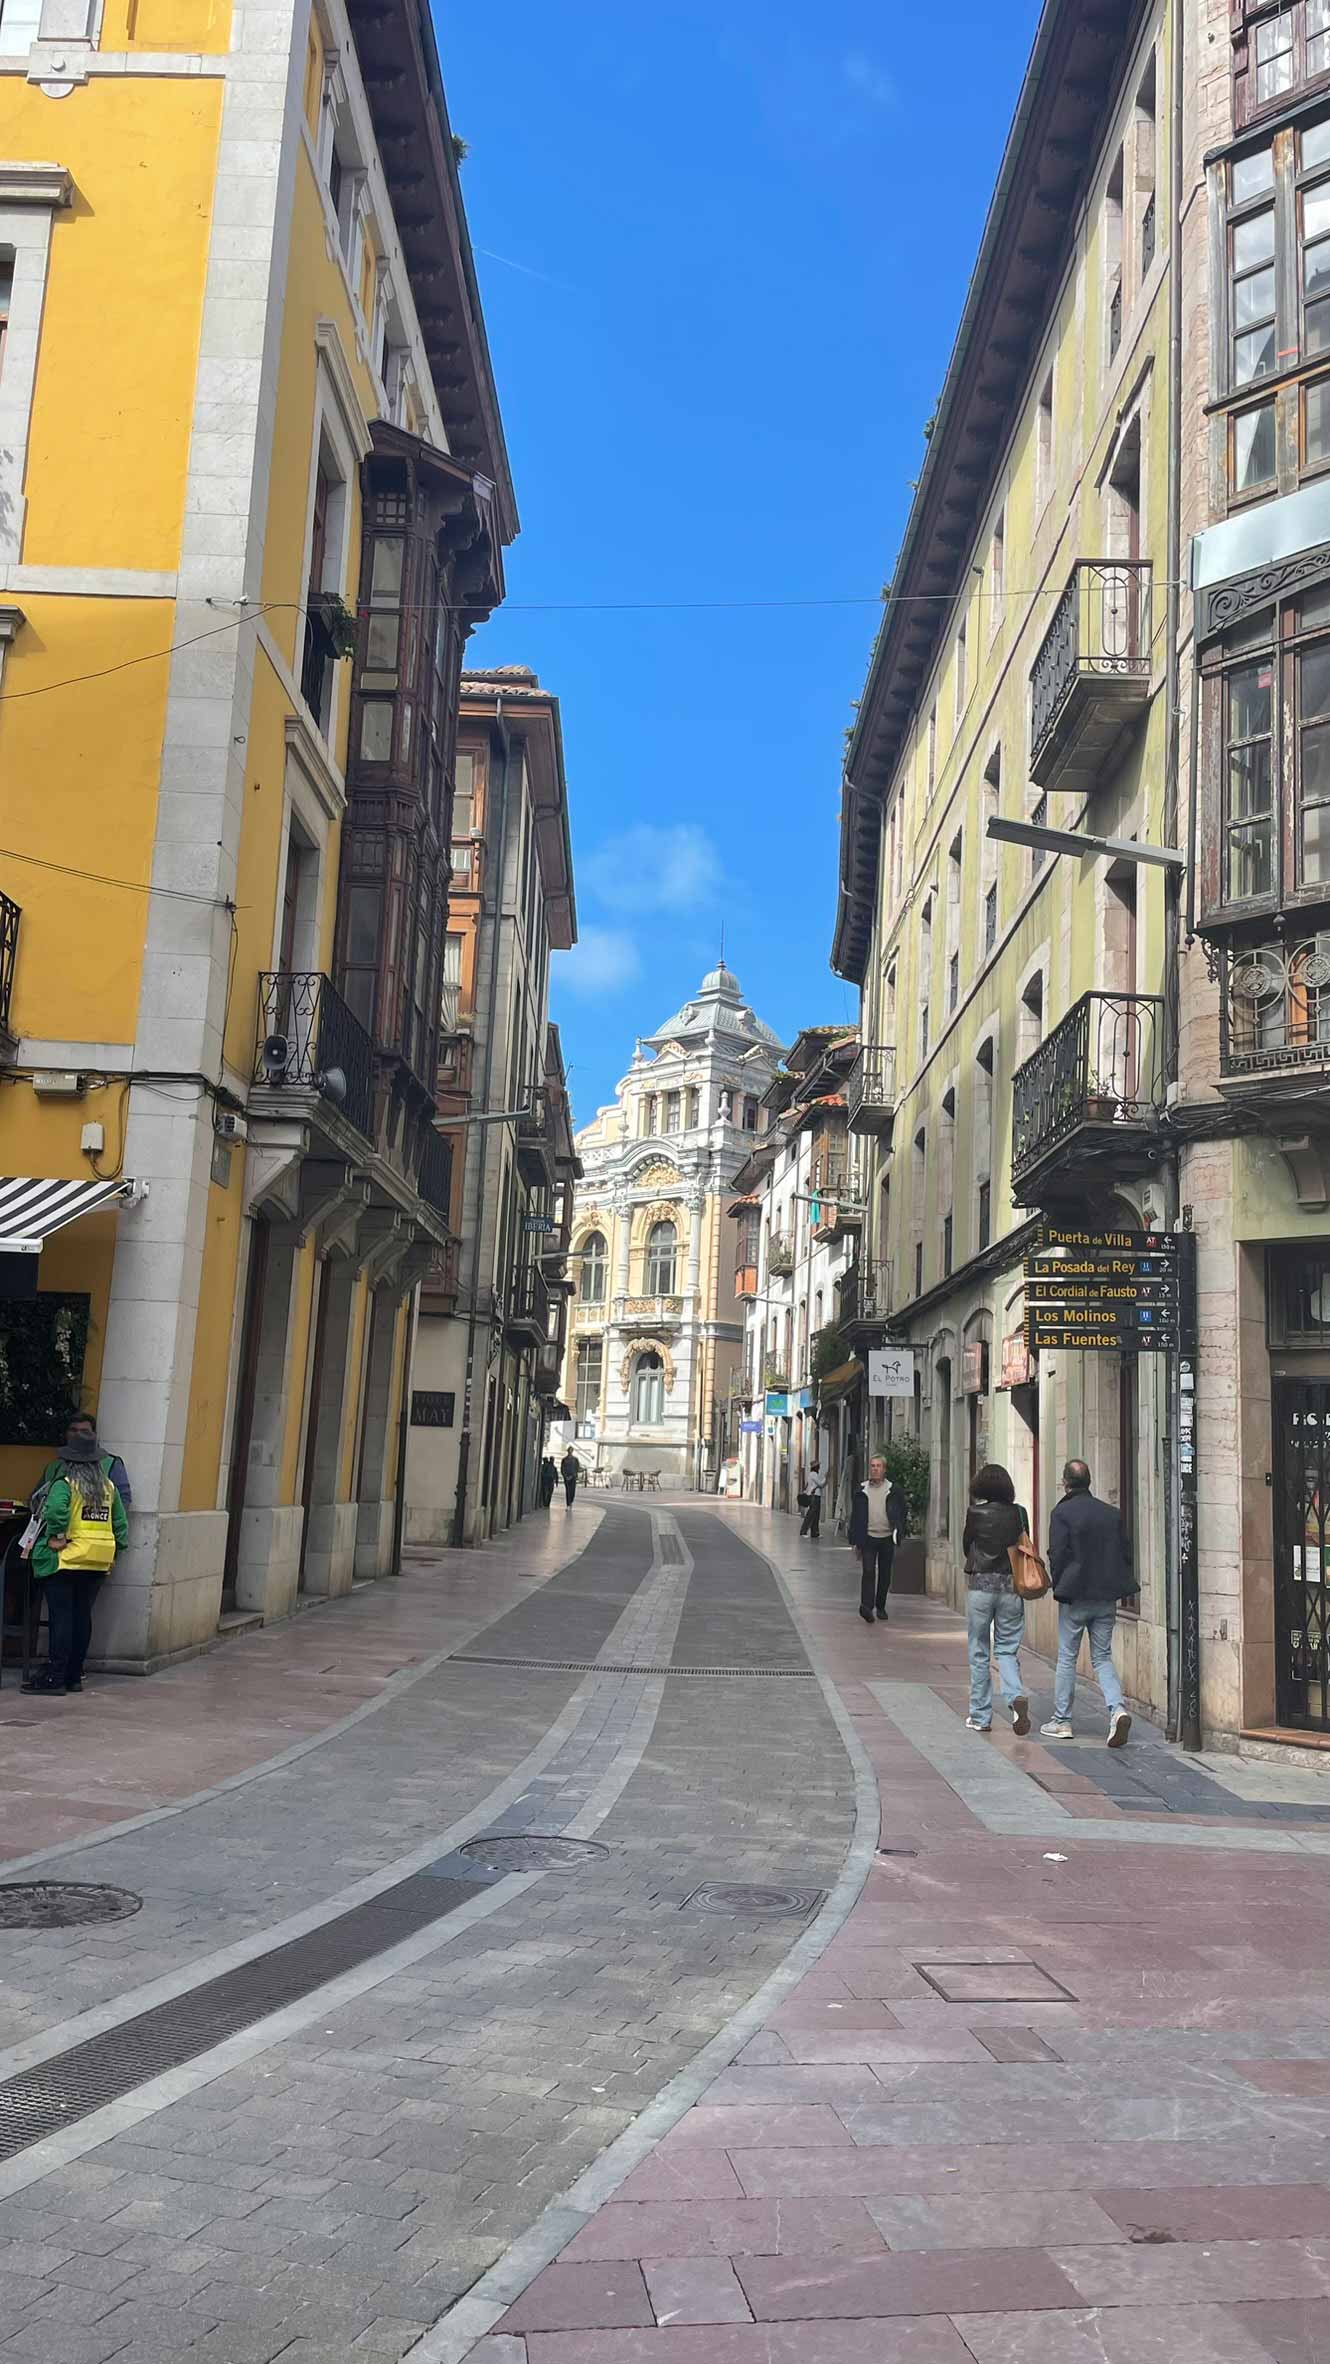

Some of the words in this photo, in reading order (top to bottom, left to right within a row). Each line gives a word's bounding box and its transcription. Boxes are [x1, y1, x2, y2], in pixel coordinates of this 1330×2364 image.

[524, 1220, 551, 1232] IBERIA
[1049, 1230, 1090, 1244] Puerta
[1092, 1237, 1102, 1245] de
[1104, 1232, 1132, 1247] Villa
[1034, 1261, 1049, 1273] La
[1052, 1260, 1095, 1274] Posada
[1097, 1265, 1109, 1273] del
[1112, 1260, 1135, 1275] Rey
[1036, 1285, 1046, 1297] El
[1050, 1284, 1088, 1298] Cordial
[1089, 1288, 1099, 1297] de
[1100, 1285, 1138, 1298] Fausto
[1036, 1310, 1058, 1322] Los
[1063, 1309, 1116, 1322] Molinos
[1035, 1332, 1058, 1344] Las
[1063, 1333, 1117, 1345] Fuentes
[872, 1374, 882, 1383] EL
